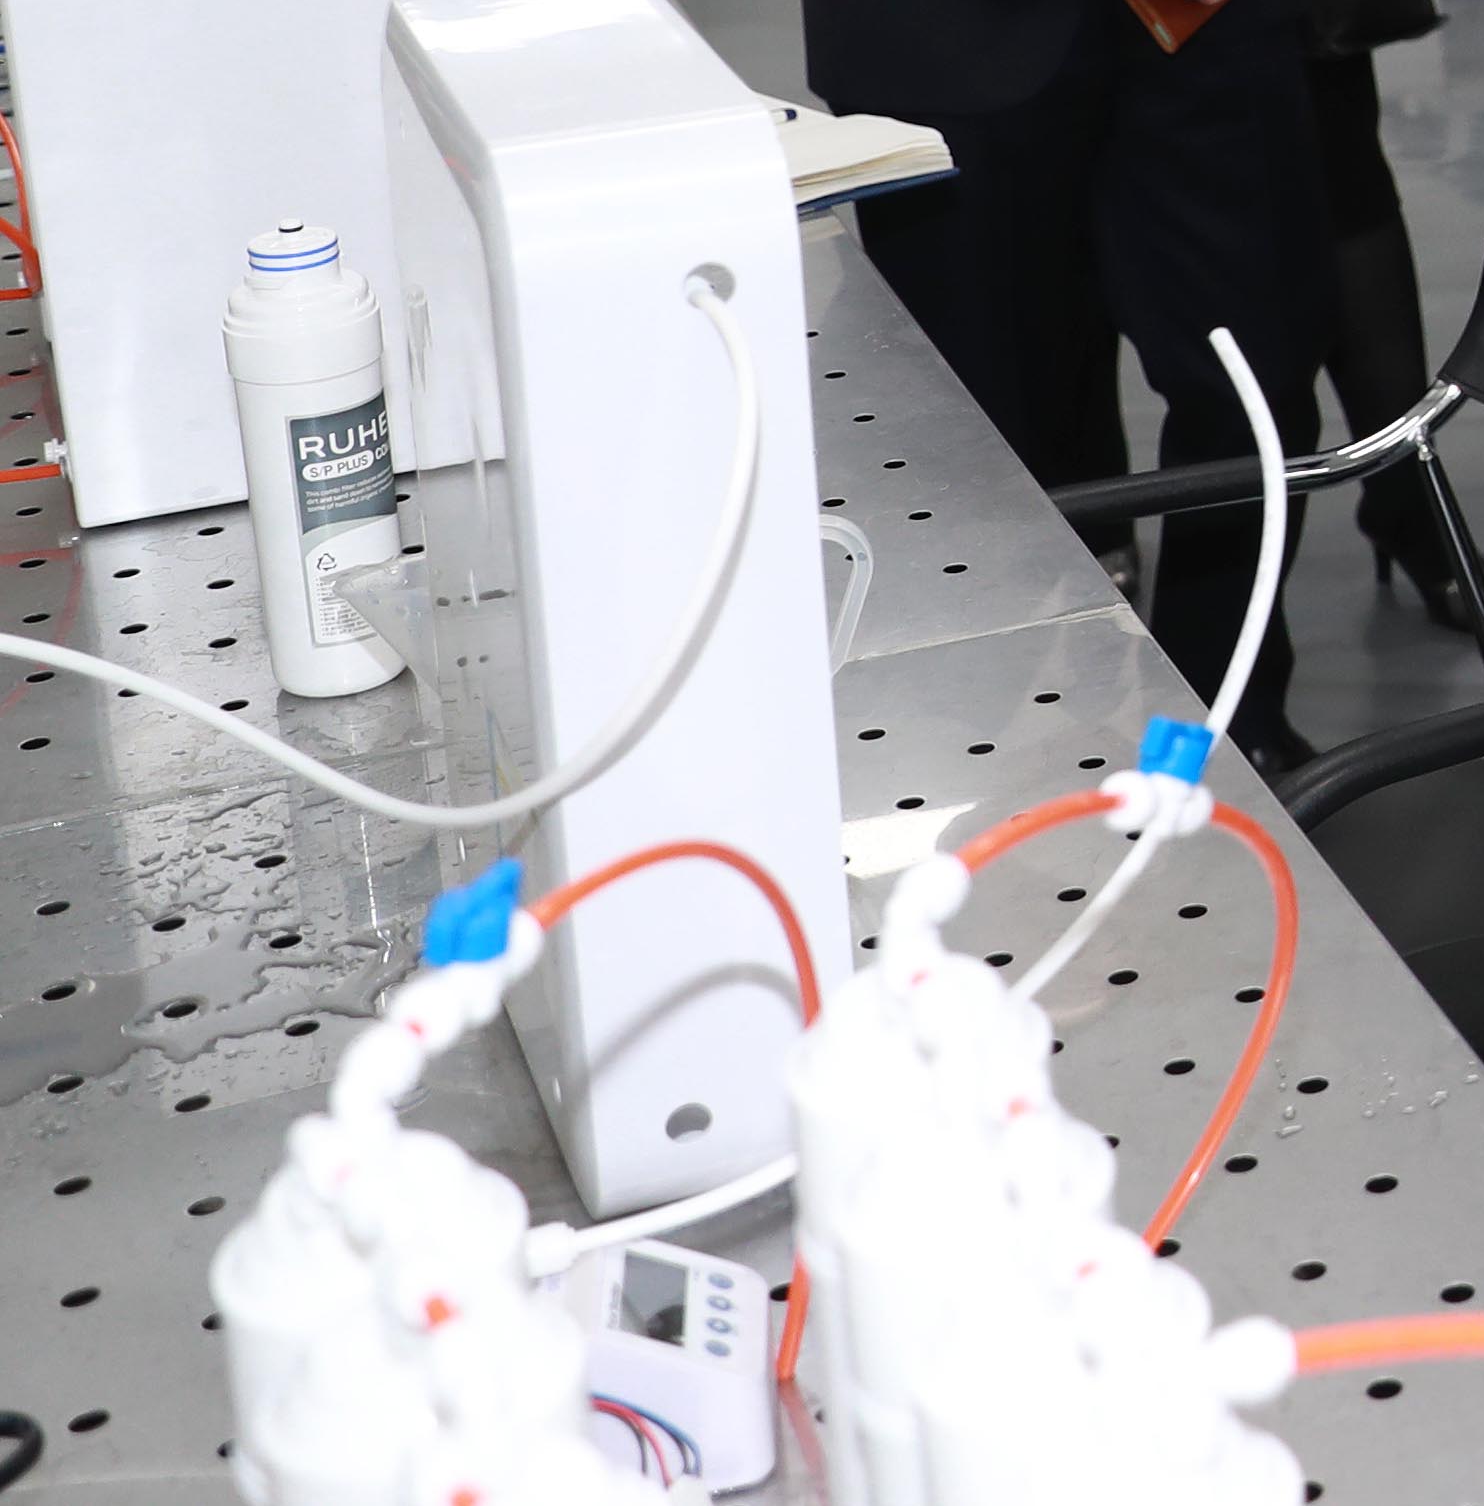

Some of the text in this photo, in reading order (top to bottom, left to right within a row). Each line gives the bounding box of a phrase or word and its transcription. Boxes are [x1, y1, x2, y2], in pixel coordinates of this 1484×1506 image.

[298, 410, 388, 461] RUHE
[309, 464, 333, 478] S/P
[337, 455, 369, 474] PLUS
